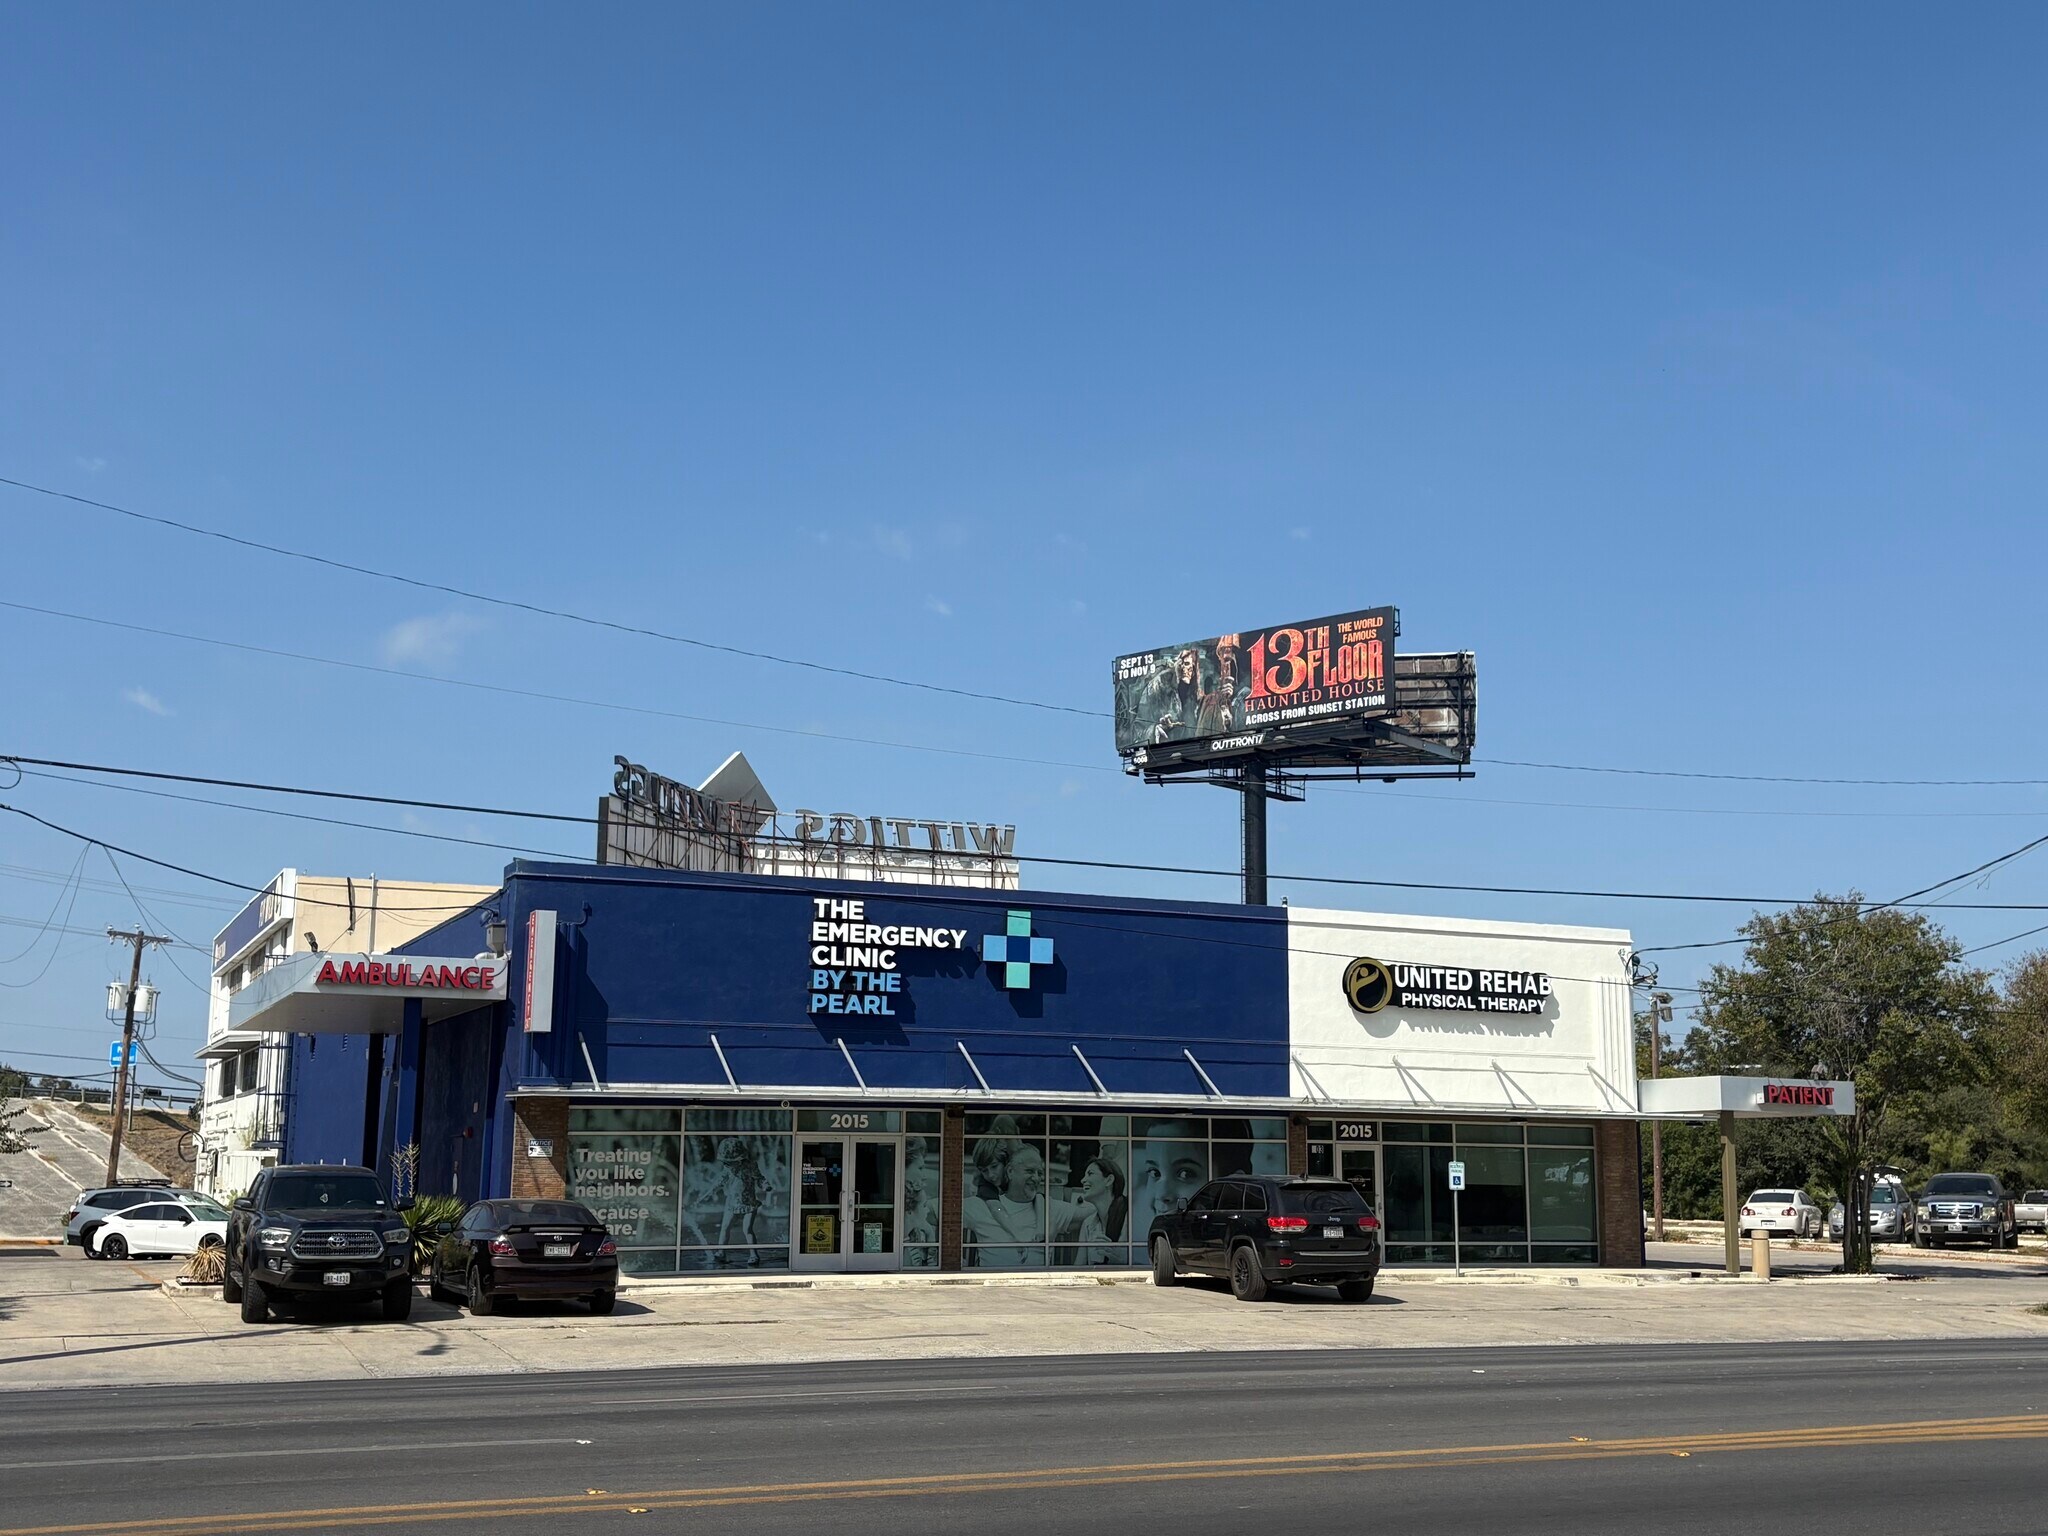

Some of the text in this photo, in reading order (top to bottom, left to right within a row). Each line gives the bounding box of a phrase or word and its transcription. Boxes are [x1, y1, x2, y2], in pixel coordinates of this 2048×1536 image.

[1337, 616, 1384, 633] THE WORLD
[1342, 629, 1377, 644] FAMOUS
[1120, 653, 1154, 669] SEPT 13
[1307, 639, 1384, 689] FLOOR
[1118, 663, 1156, 680] TO NOV 9
[1244, 678, 1385, 712] HAUNTED HOUSE
[1245, 694, 1386, 725] ACROSS FROM SUNSET STATION
[813, 898, 865, 920] THE
[812, 921, 967, 949] EMERGENCY
[811, 945, 897, 970] CLINIC
[314, 960, 495, 990] AMBULANCE
[813, 969, 901, 992] BY THE
[1394, 966, 1552, 995] UNITED REHAB
[811, 993, 896, 1015] PEARL
[1401, 992, 1546, 1012] PHYSICAL THERAPY
[1767, 1085, 1834, 1105] PATIENT
[830, 1114, 869, 1128] 2015
[1340, 1124, 1373, 1138] 2015
[576, 1148, 652, 1165] Treating
[575, 1165, 645, 1182] you like
[574, 1182, 670, 1199] neighbors.
[589, 1205, 649, 1220] ecause
[1327, 1215, 1341, 1223] Jeep
[605, 1223, 637, 1236] are.
